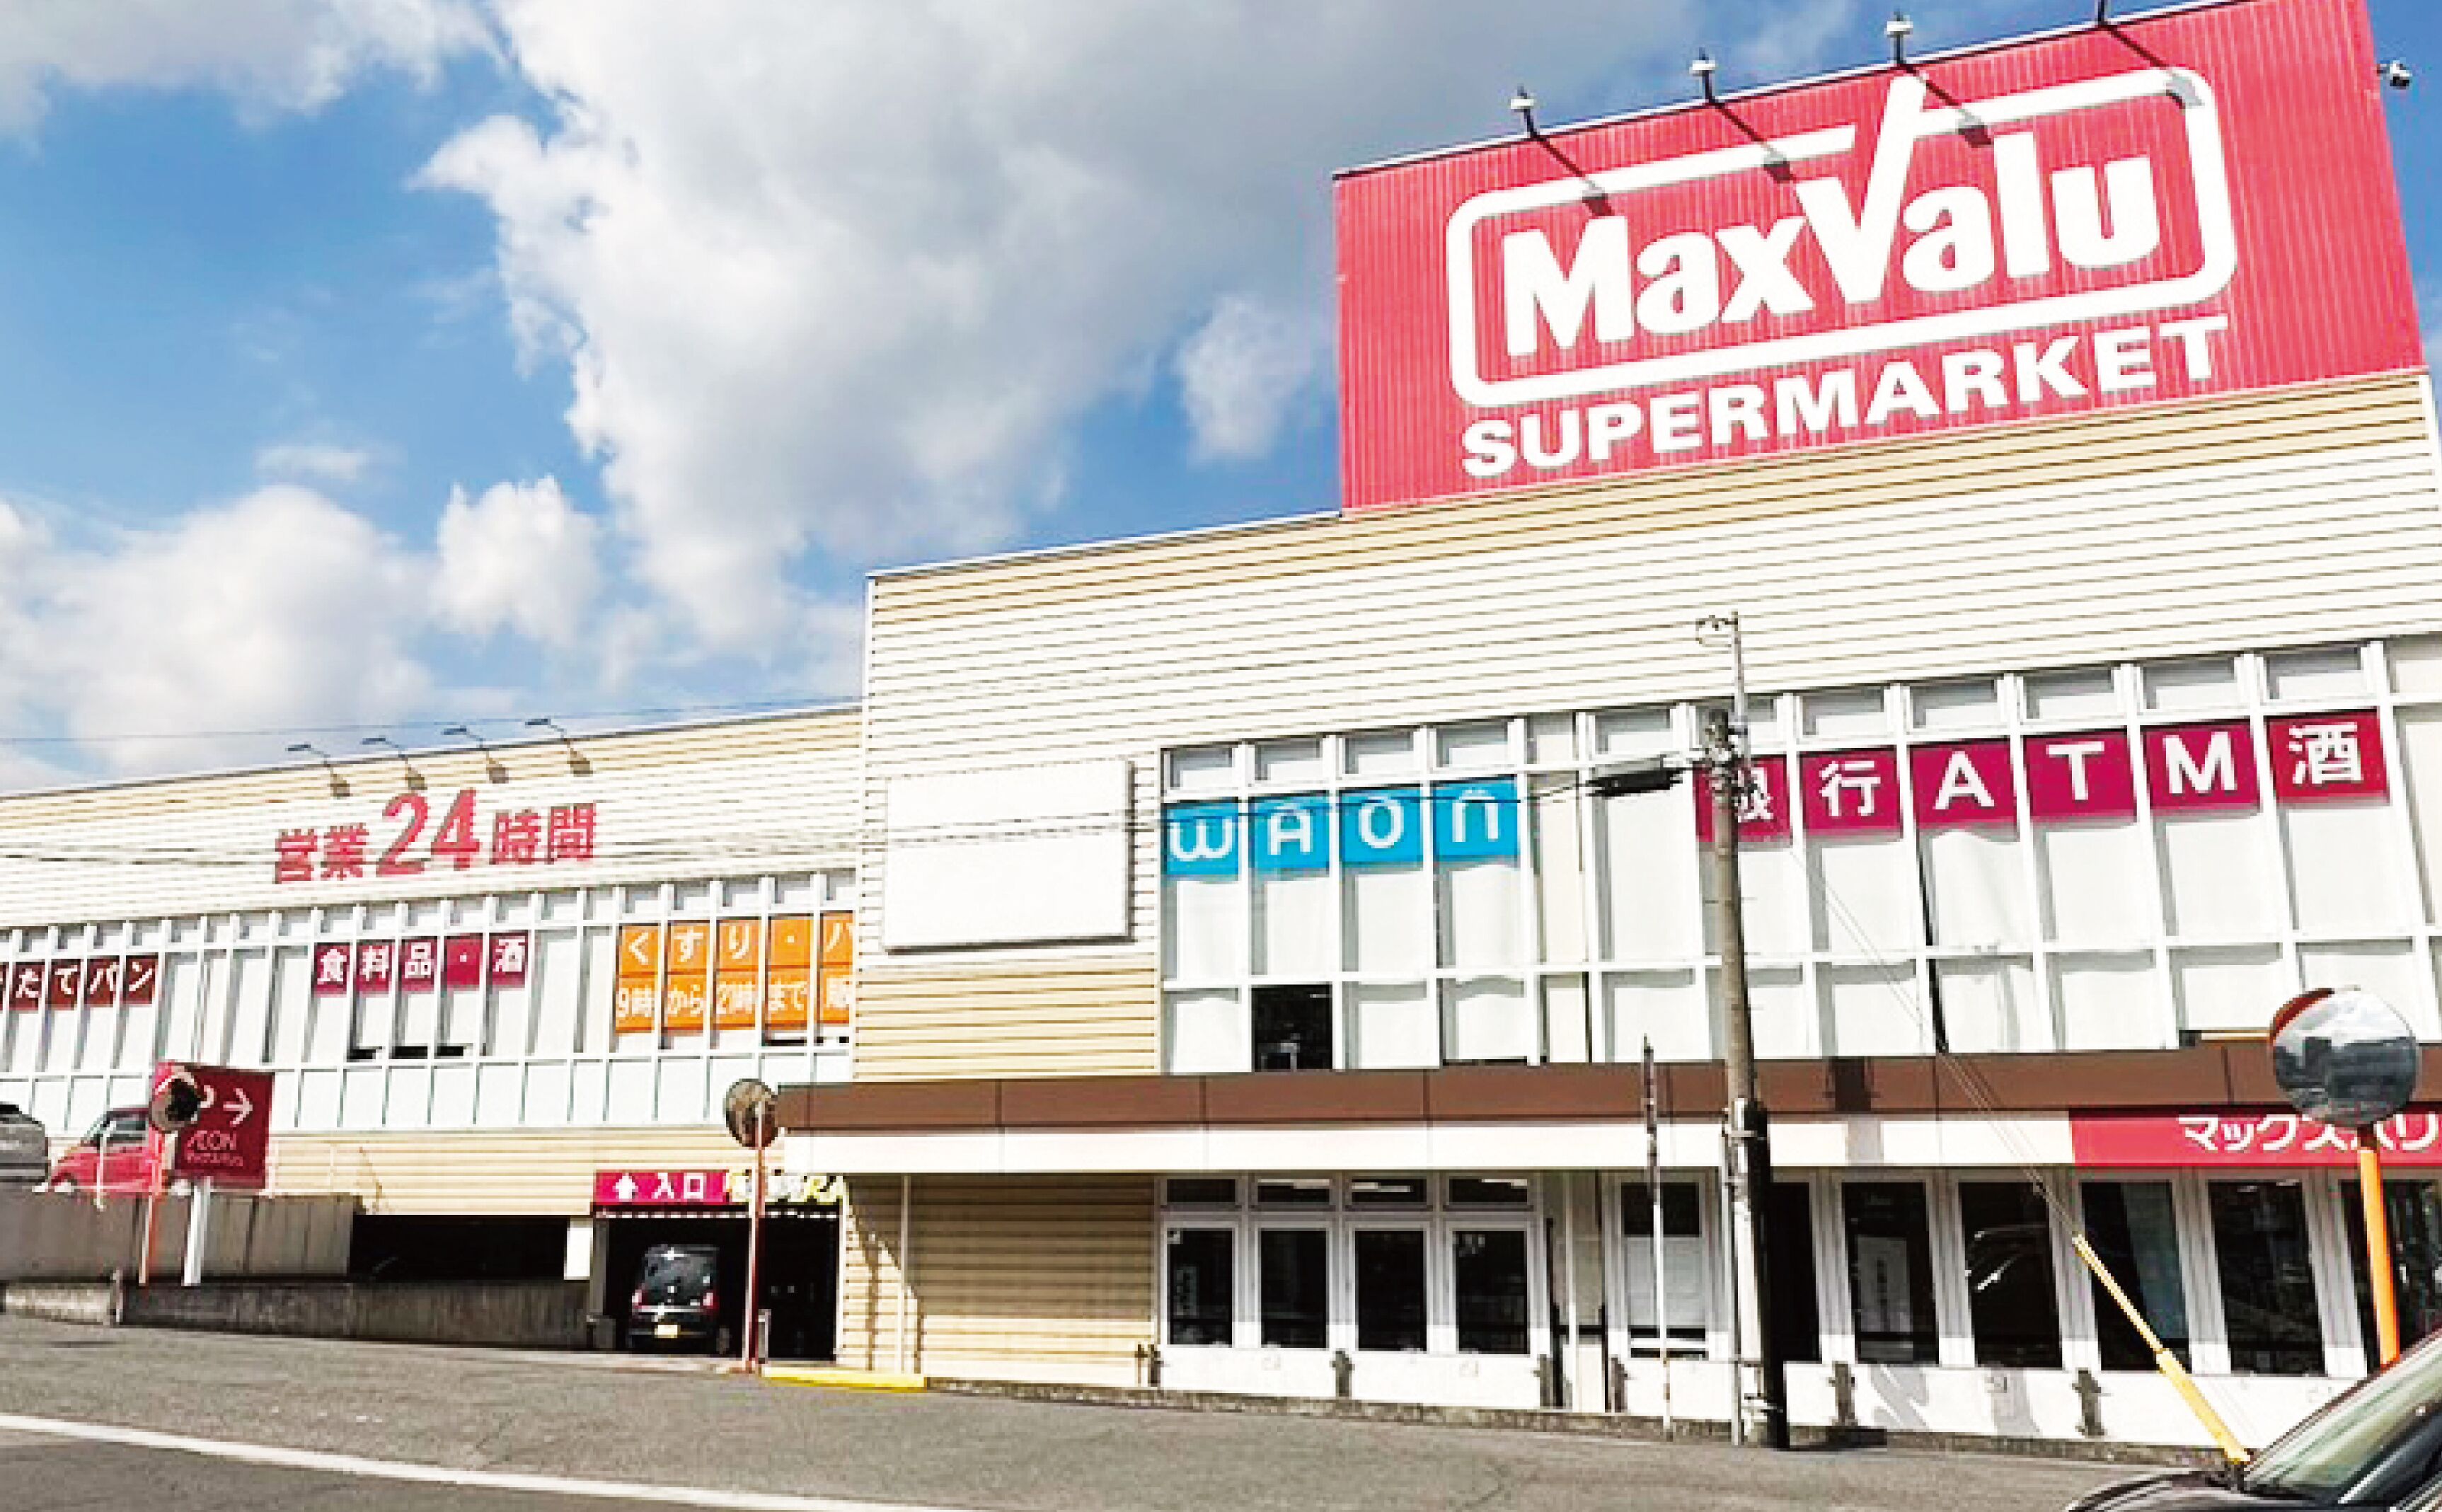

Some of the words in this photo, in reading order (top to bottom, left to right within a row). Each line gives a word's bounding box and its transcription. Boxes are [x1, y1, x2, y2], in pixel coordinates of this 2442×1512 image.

[1502, 72, 2162, 357] MaxValu
[1462, 316, 2229, 479] SUPERMARKET
[275, 787, 597, 884] 営業24時間
[0, 960, 154, 998] たてパン
[654, 1172, 705, 1200] 入口
